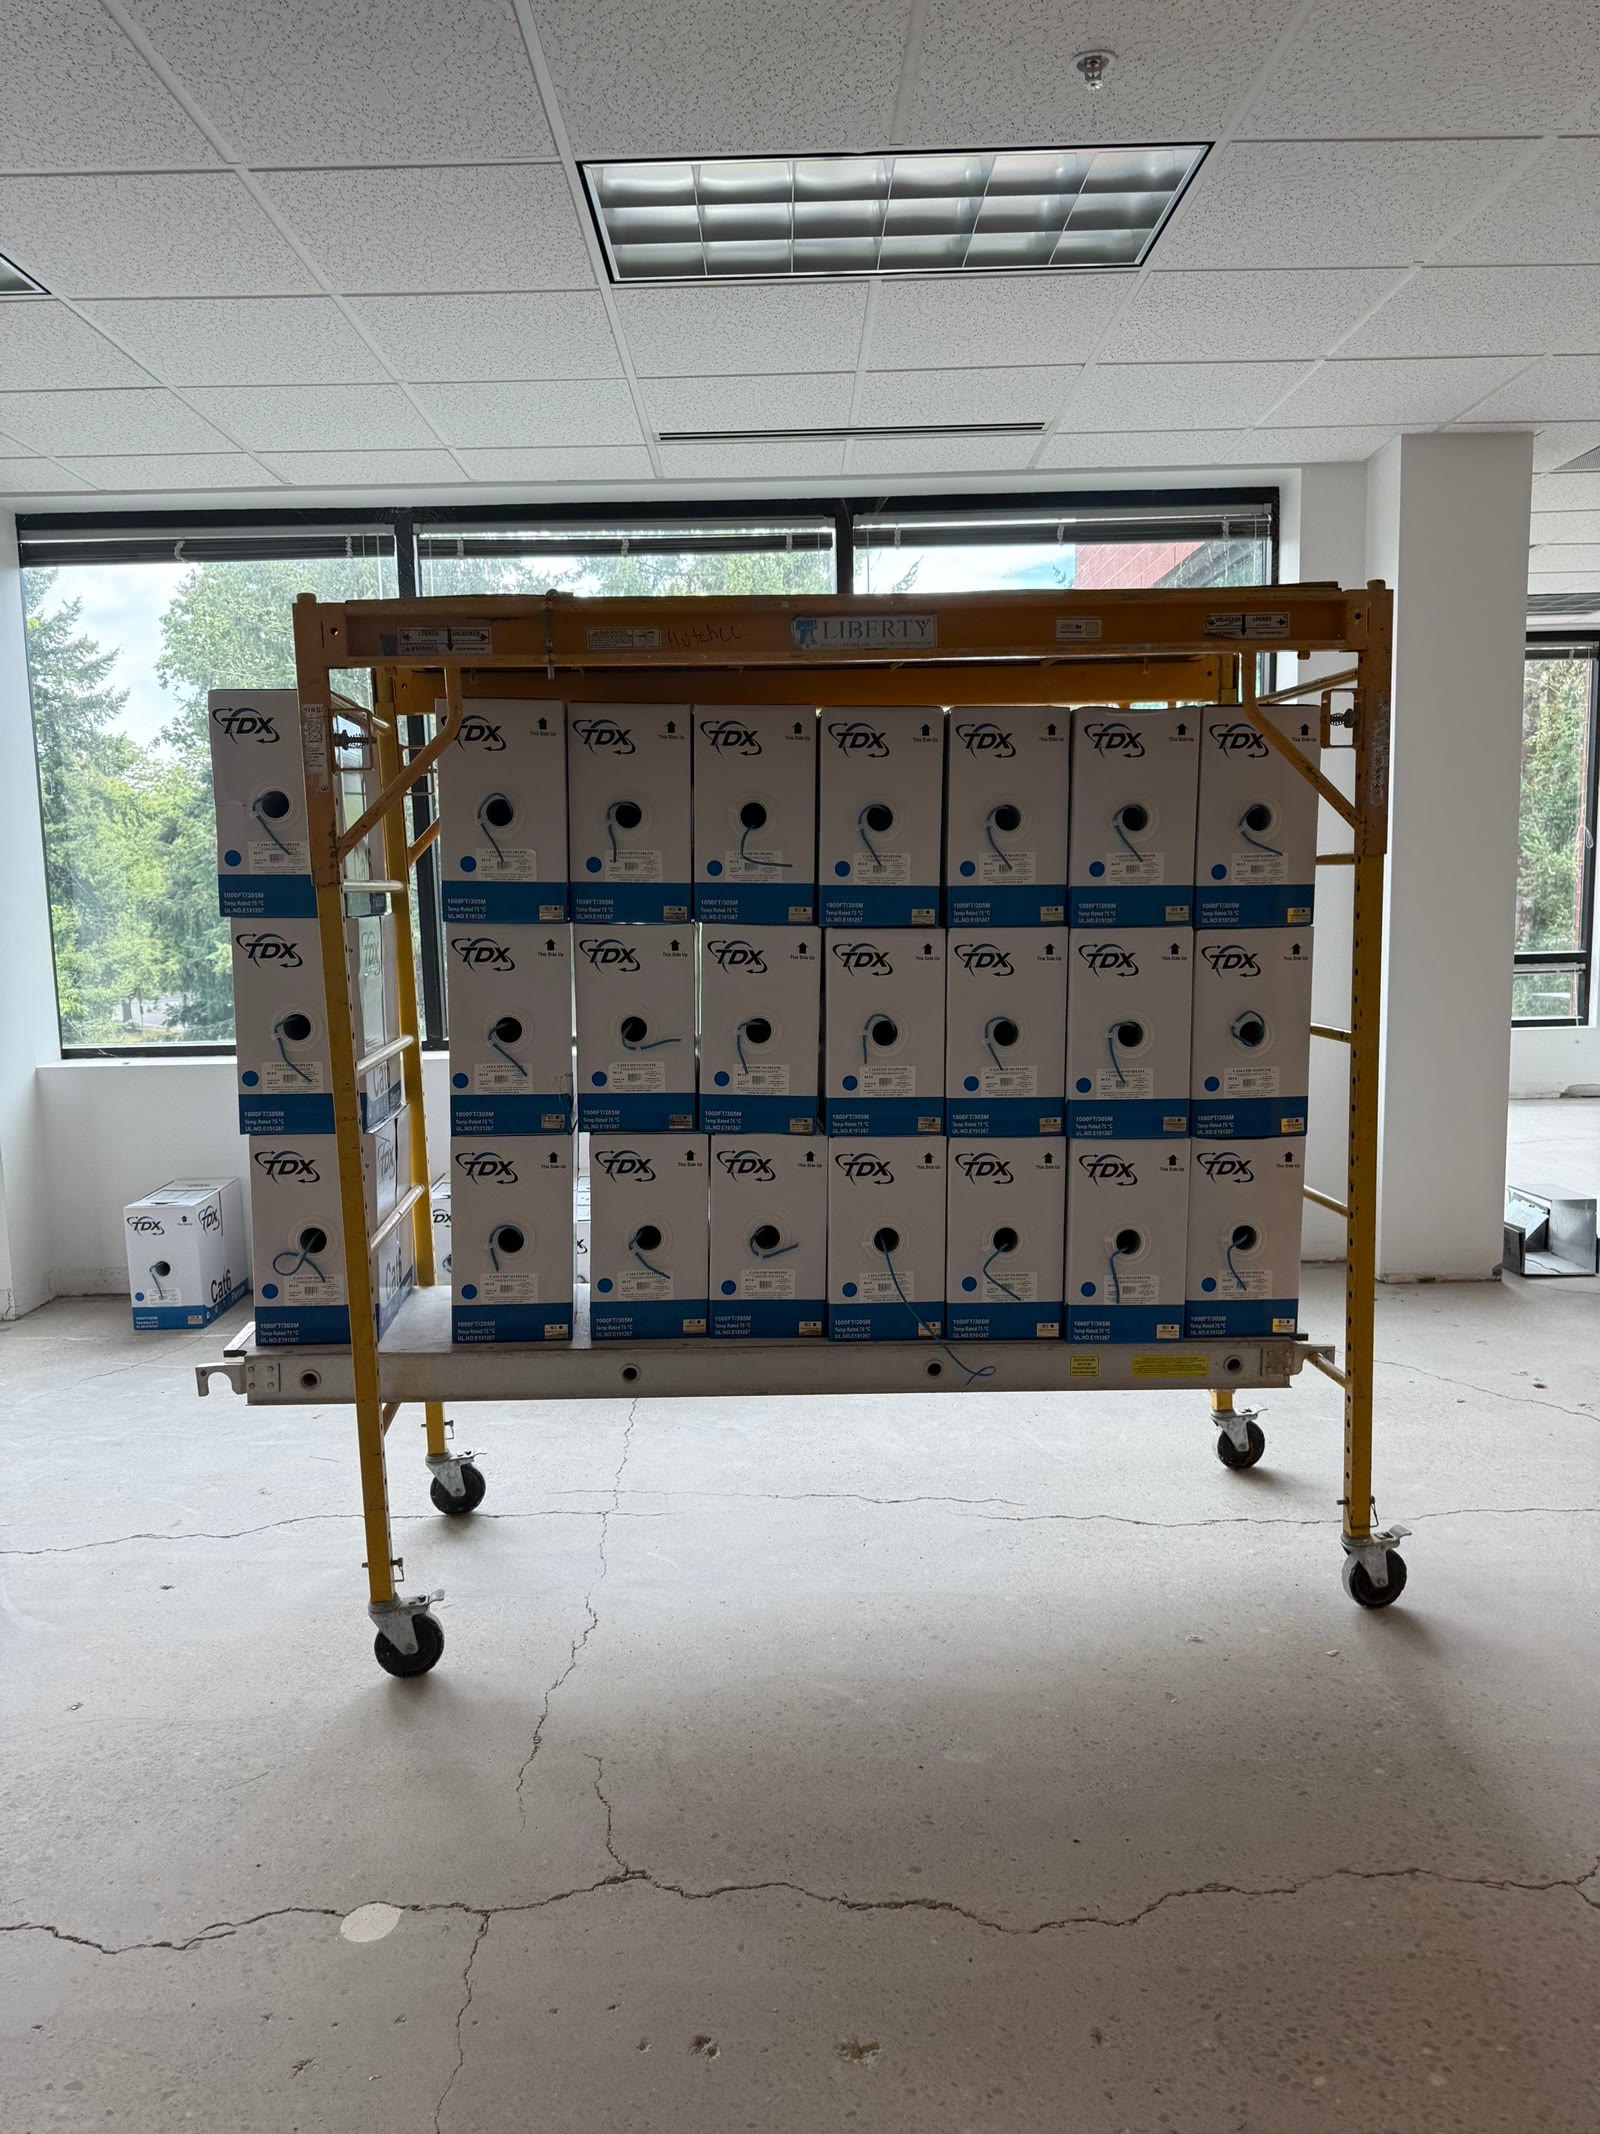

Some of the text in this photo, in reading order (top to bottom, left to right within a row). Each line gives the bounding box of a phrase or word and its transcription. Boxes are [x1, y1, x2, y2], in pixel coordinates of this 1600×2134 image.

[823, 619, 930, 639] LIBERTY
[220, 716, 276, 735] TDX
[580, 728, 632, 746] TDX
[708, 730, 760, 747] TDX
[835, 732, 887, 749] TDX
[963, 732, 1014, 749] TDX
[1091, 732, 1143, 749] TDX
[1216, 732, 1265, 749] TDX
[244, 942, 298, 959] TDX
[460, 947, 512, 964] TDX
[587, 947, 637, 964] TDX
[714, 949, 765, 966] TDX
[840, 951, 890, 968] TDX
[961, 952, 1012, 969] TDX
[1085, 952, 1137, 969] TDX
[1209, 953, 1258, 970] TDX
[262, 1159, 316, 1176] TDX
[463, 1160, 516, 1176] TDX
[603, 1158, 653, 1174] TDX
[724, 1158, 773, 1174] TDX
[842, 1160, 892, 1177] TDX
[962, 1161, 1012, 1177] TDX
[1086, 1162, 1136, 1178] TDX
[1204, 1159, 1252, 1175] TDX
[131, 1220, 162, 1232] TDX
[201, 1208, 218, 1230] TDX
[210, 1268, 232, 1304] Cat6
